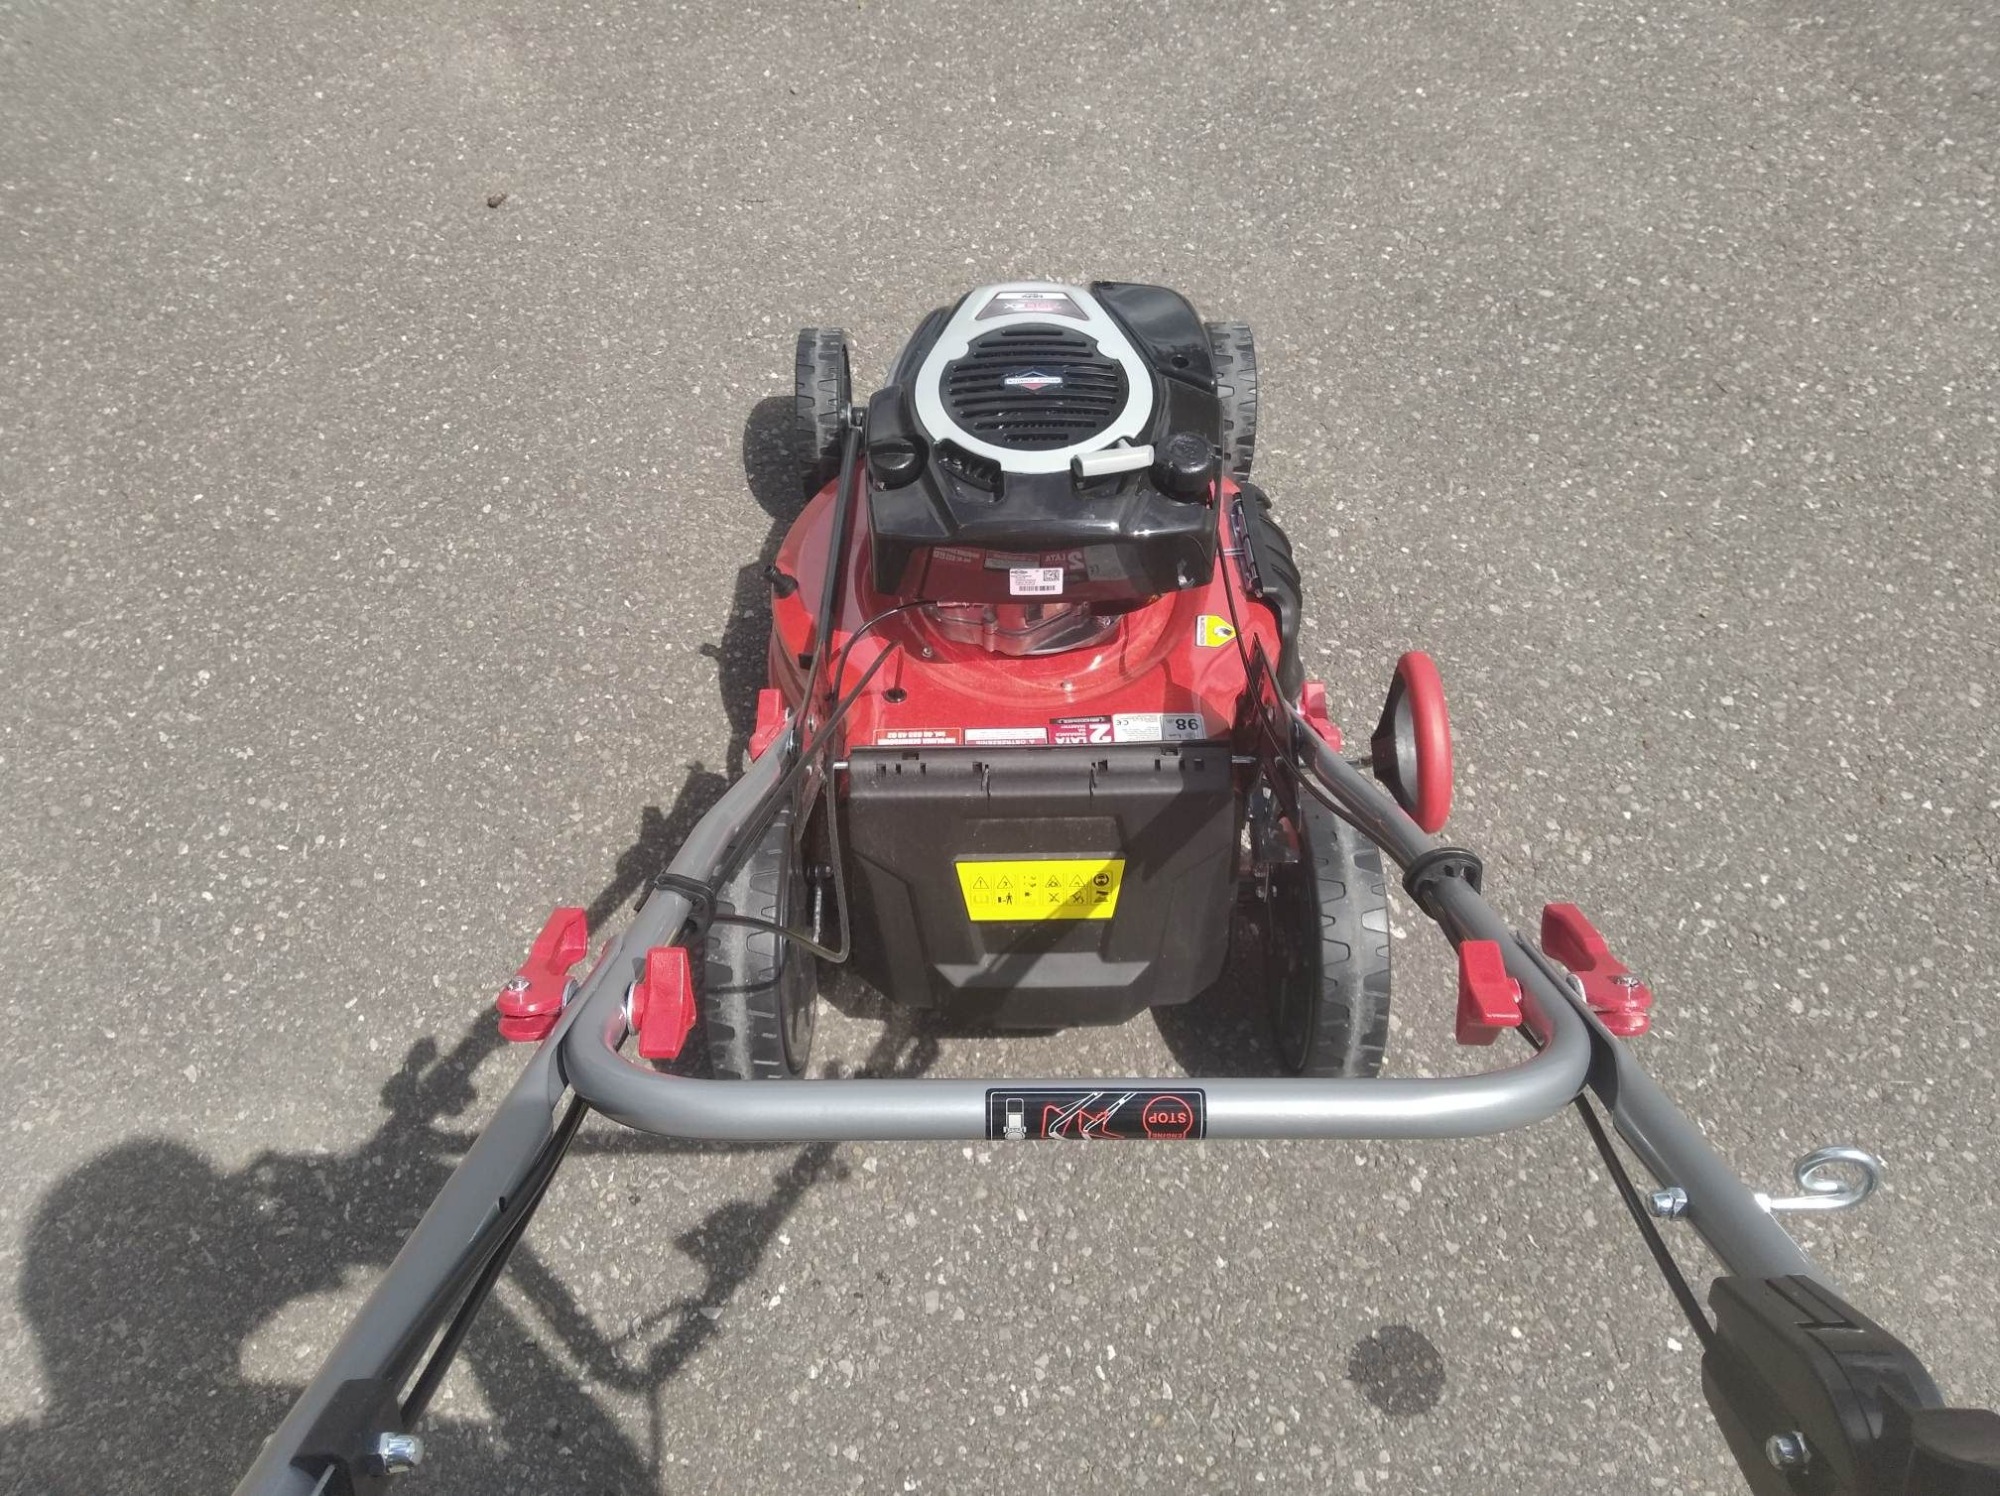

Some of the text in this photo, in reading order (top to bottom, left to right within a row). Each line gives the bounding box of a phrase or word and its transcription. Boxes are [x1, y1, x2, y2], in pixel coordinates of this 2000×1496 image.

[1176, 718, 1199, 731] 98
[1089, 723, 1112, 743] 2
[1055, 736, 1087, 744] LATA
[1148, 1112, 1187, 1124] STOP
